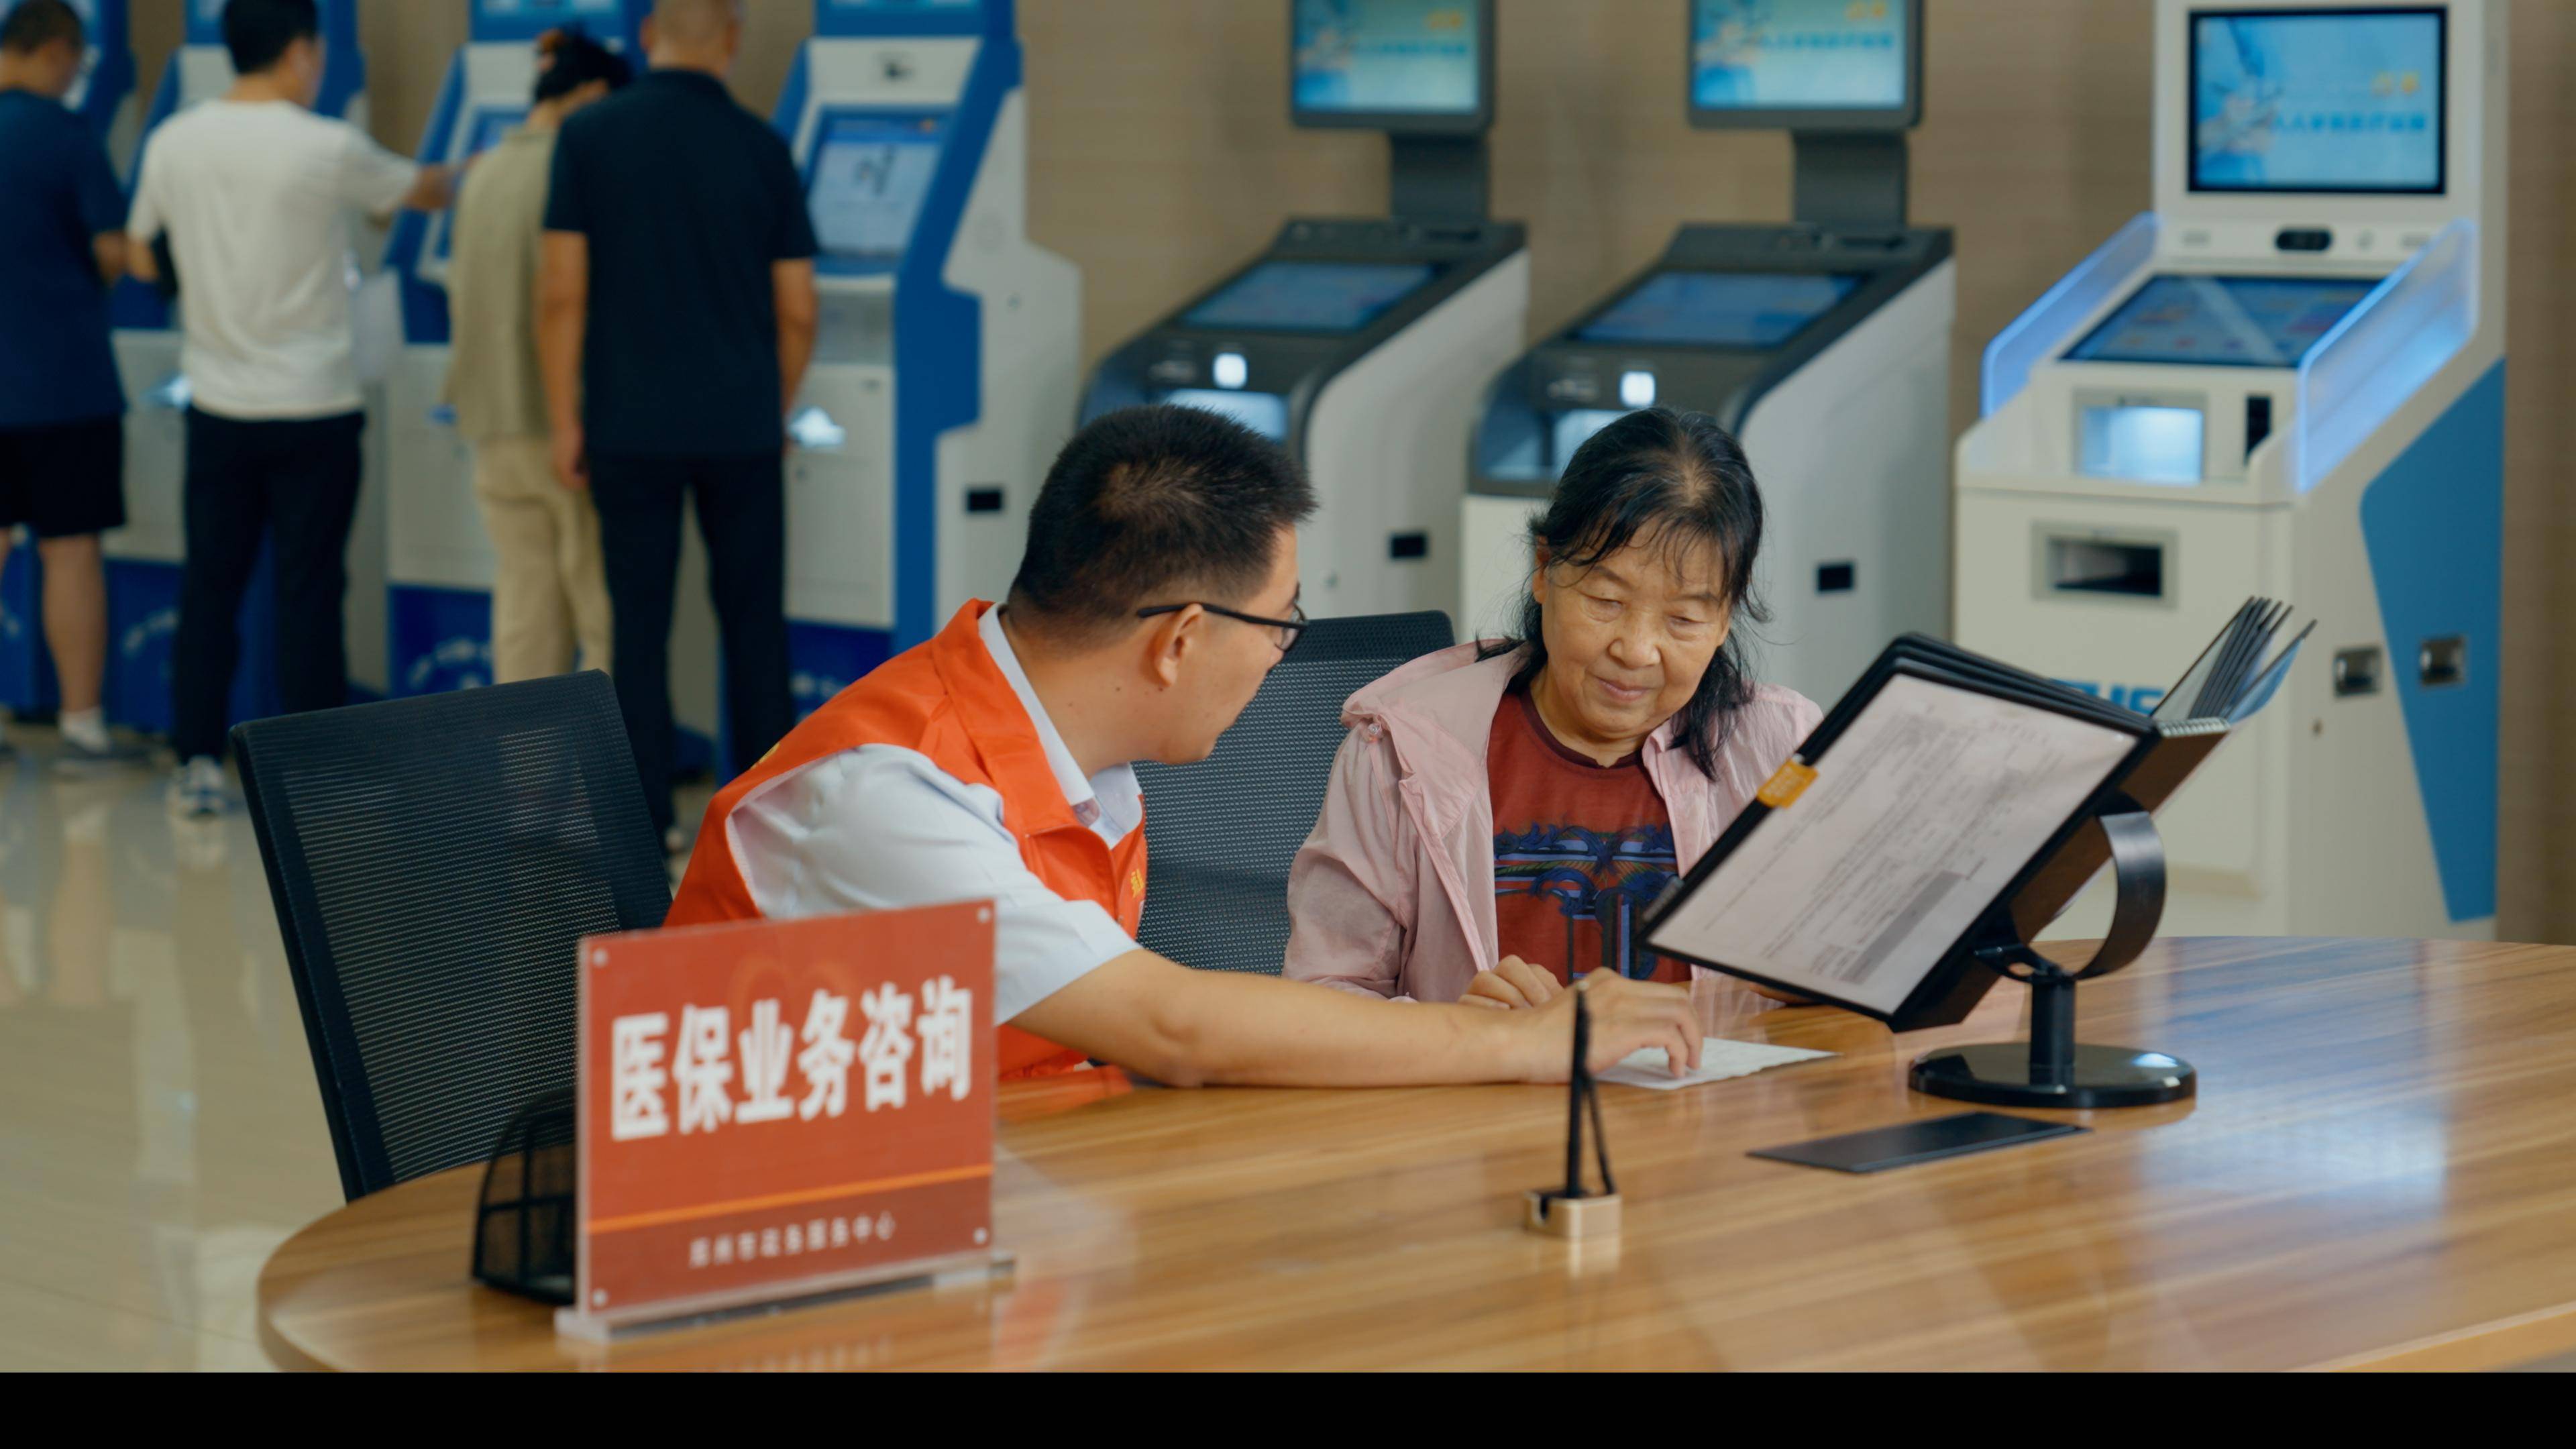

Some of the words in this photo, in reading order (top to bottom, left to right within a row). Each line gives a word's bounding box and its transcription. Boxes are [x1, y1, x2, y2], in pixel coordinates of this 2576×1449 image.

[611, 974, 973, 1140] 医保业务咨询
